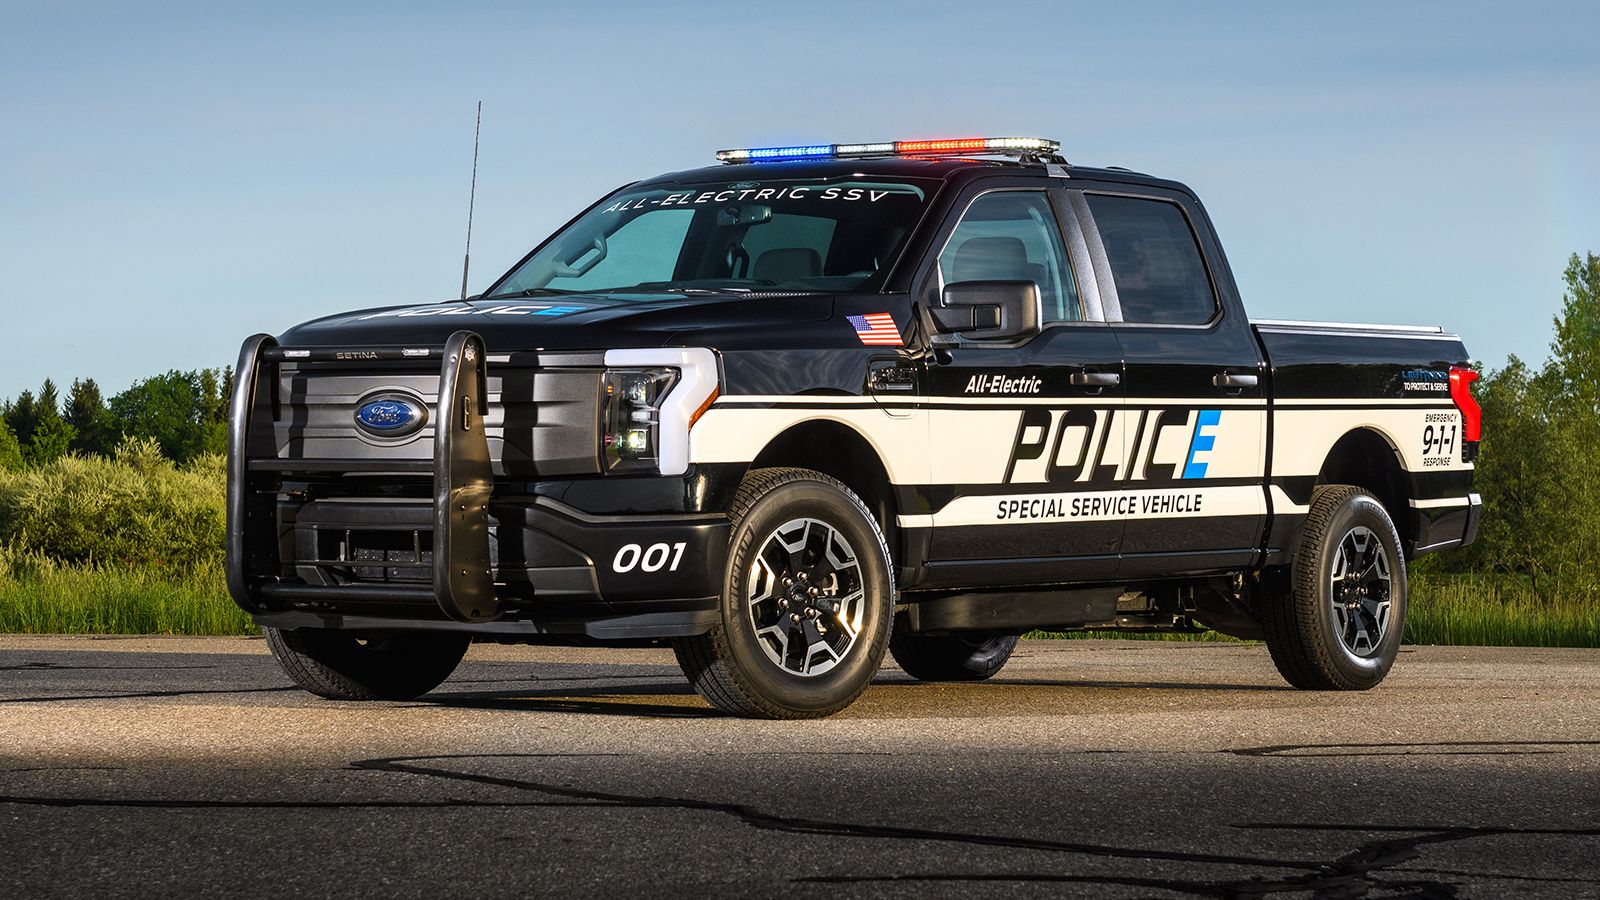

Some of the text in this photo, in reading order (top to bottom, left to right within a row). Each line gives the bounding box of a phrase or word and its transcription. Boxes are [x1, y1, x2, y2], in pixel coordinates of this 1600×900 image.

[602, 187, 889, 214] ALL-ELECTRIC SSV
[336, 351, 378, 360] SETINA
[965, 375, 1042, 394] All-Electric
[1403, 382, 1410, 391] TO
[1410, 382, 1430, 391] PROTECT
[1434, 382, 1448, 391] SERVE
[1425, 413, 1457, 422] EMERGENCY
[1002, 409, 1222, 484] POLICE
[1422, 425, 1456, 455] 9-1-1
[1423, 457, 1450, 466] RESPONSE
[997, 494, 1203, 520] SPECIAL SERVICE VEHICLE
[612, 542, 687, 573] 001
